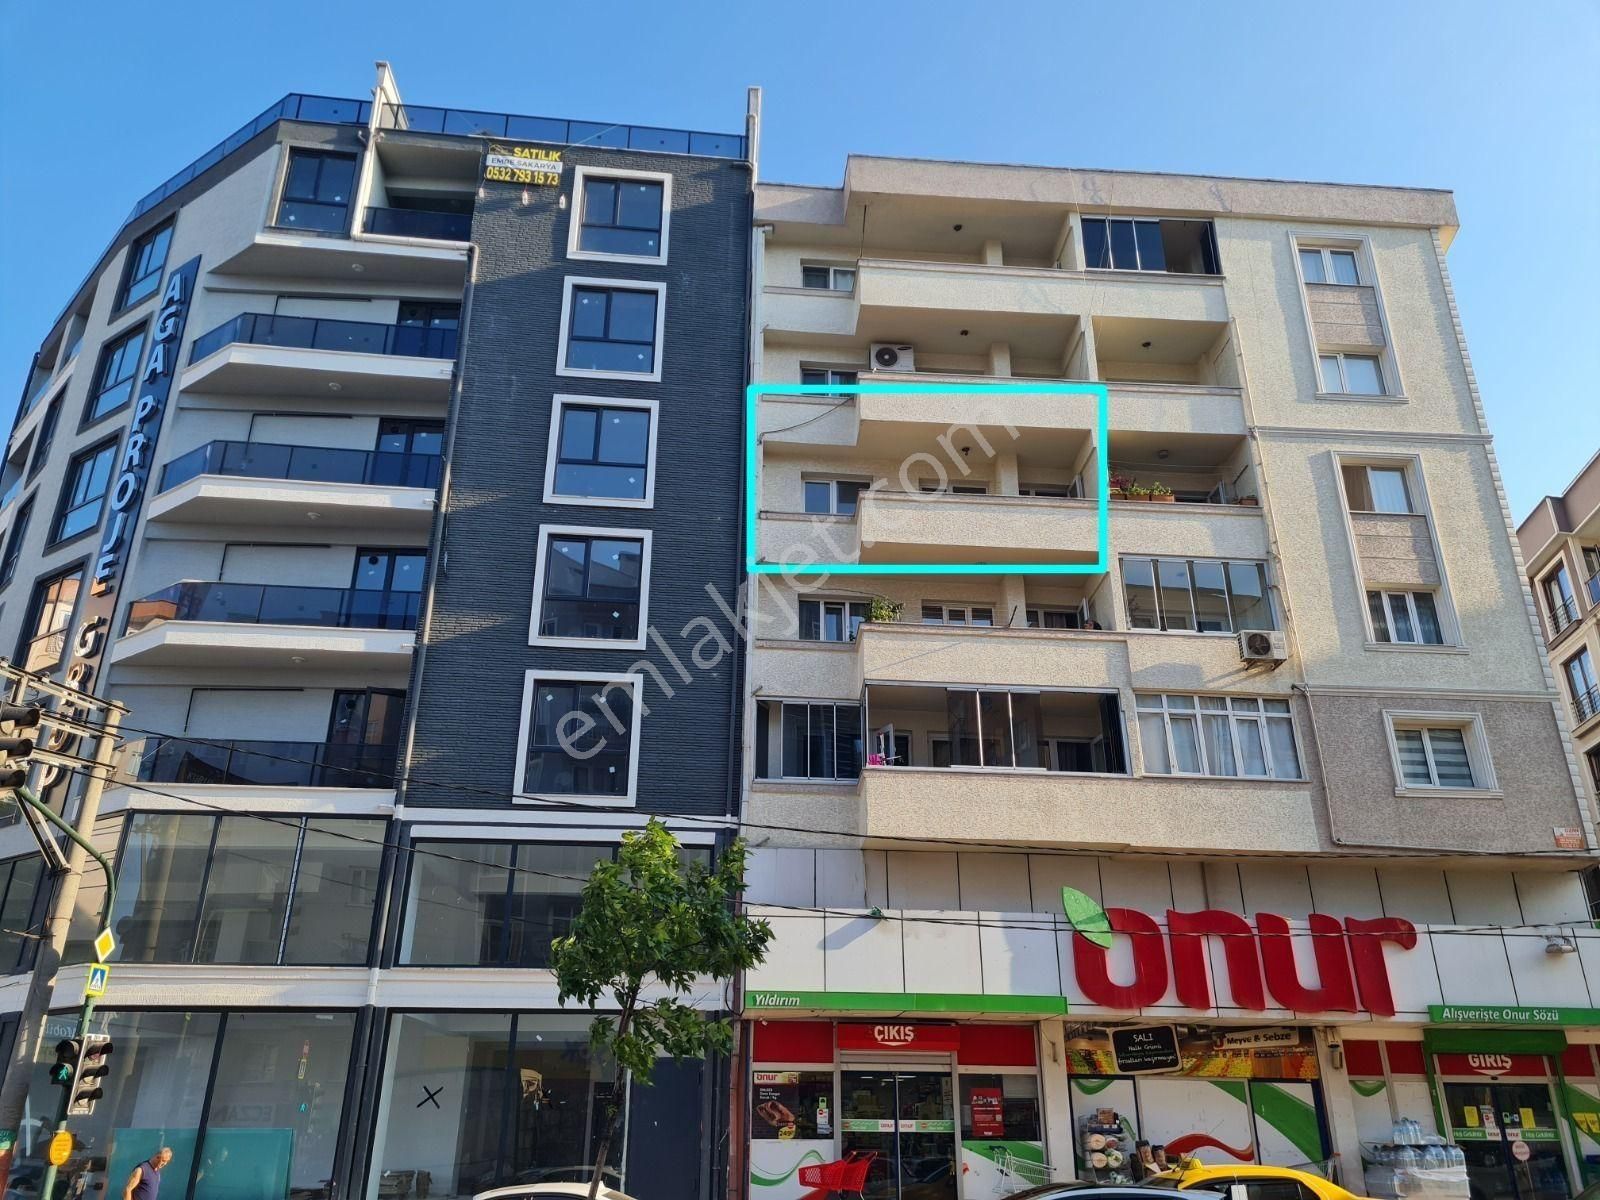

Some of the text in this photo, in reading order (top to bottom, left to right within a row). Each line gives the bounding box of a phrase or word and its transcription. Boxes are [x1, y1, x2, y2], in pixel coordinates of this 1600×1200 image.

[513, 147, 561, 161] SATILIK
[516, 160, 557, 170] SAKARYA
[486, 166, 559, 186] 0532 793 15 73
[144, 272, 185, 384] AGA
[91, 395, 156, 597] PROJE
[755, 994, 800, 1007] Yıldırım
[1442, 1007, 1559, 1022] Alışverişte Onur Sözü
[874, 1025, 915, 1042] ÇIKIŞ
[1226, 1031, 1292, 1046] Meyve & Sebze
